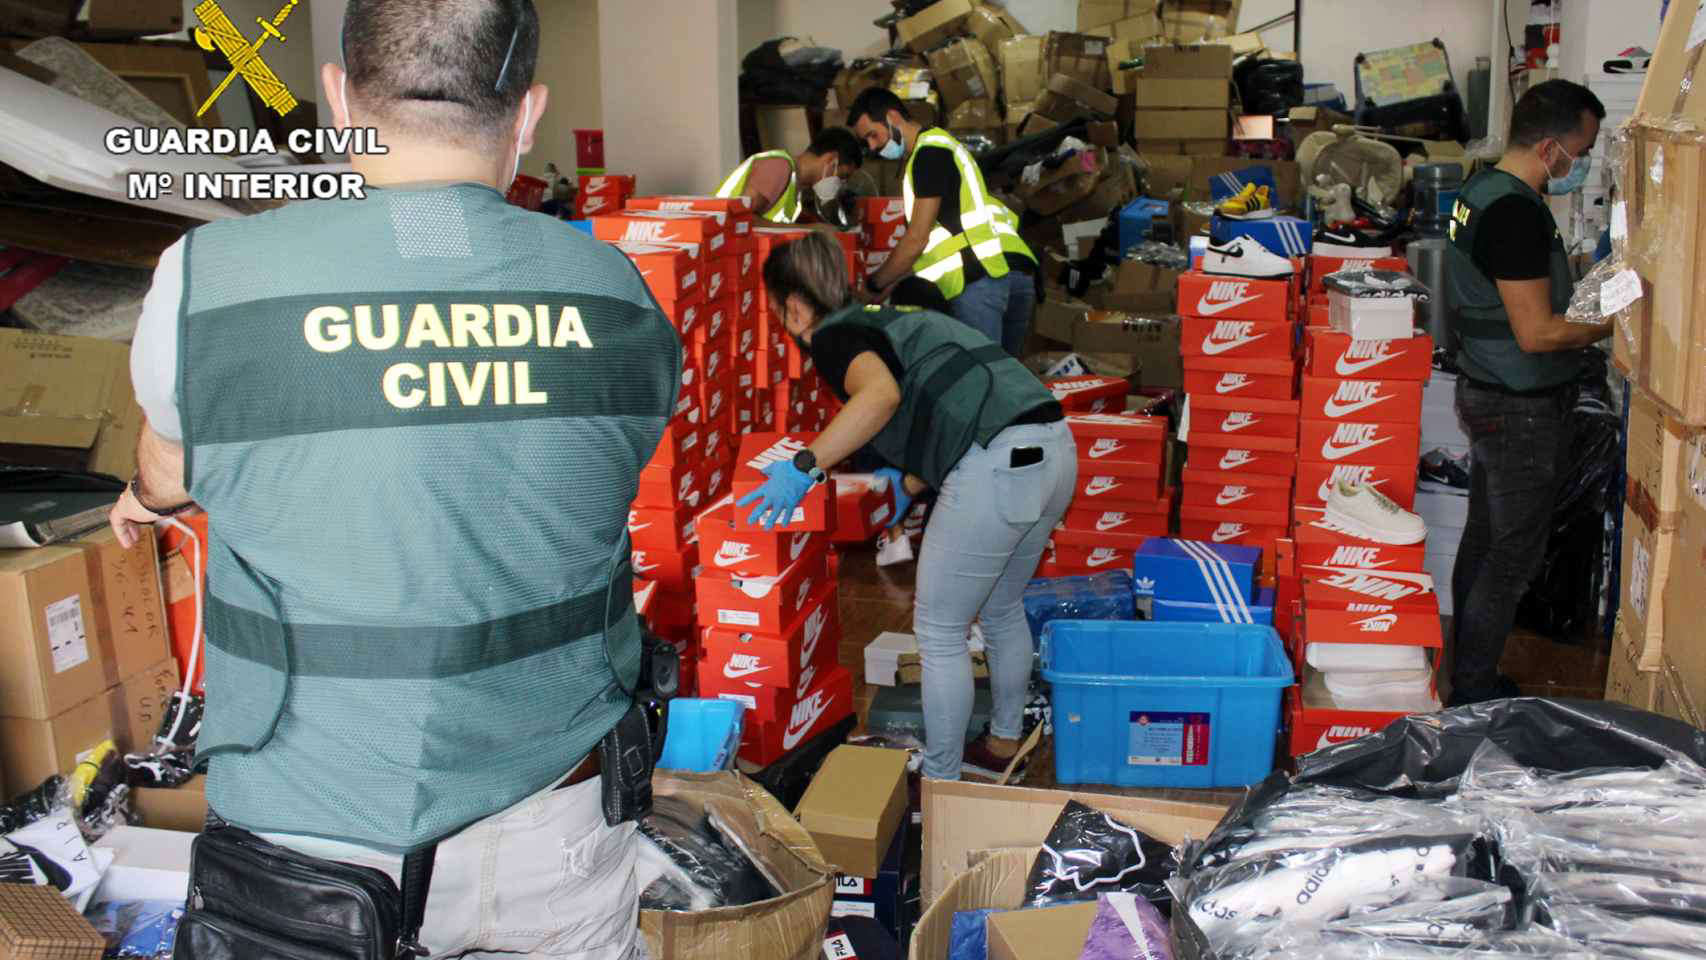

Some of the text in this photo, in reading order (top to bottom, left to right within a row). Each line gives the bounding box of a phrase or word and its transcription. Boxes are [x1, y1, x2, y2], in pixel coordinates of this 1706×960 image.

[1206, 281, 1250, 300] NIKE
[303, 303, 594, 352] GUARDIA
[1212, 321, 1254, 339] NIKE
[1346, 340, 1390, 359] NIKE
[382, 361, 548, 409] CIVIL
[1334, 381, 1381, 400] NIKE
[1332, 423, 1379, 443] NIKE
[720, 541, 751, 556] NIKE
[1331, 545, 1380, 565] NIKE
[730, 654, 760, 668] NIKE
